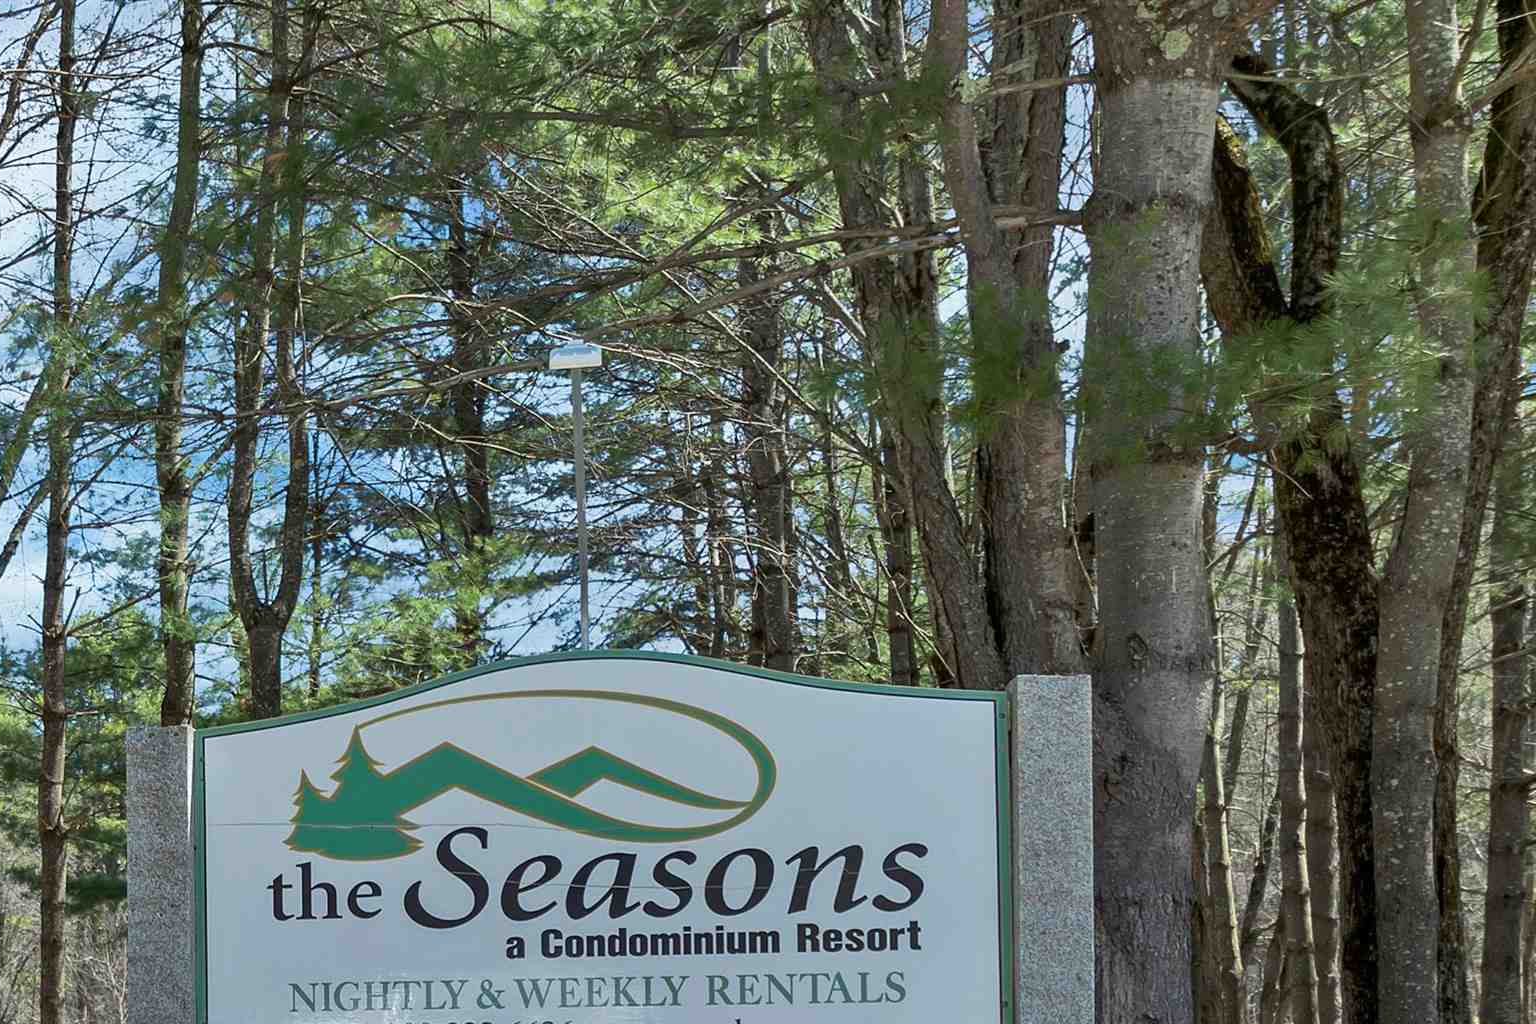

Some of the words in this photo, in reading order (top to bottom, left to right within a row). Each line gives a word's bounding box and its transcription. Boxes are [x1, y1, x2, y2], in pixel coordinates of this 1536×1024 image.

[267, 861, 383, 922] the
[402, 826, 930, 930] Seasons
[505, 934, 526, 960] a
[540, 924, 781, 958] Condominium
[796, 920, 923, 954] Resort
[288, 979, 471, 1013] NIGHTLY
[475, 980, 506, 1011] &
[512, 974, 692, 1010] WEEKLY
[703, 970, 908, 1007] RENTALS
